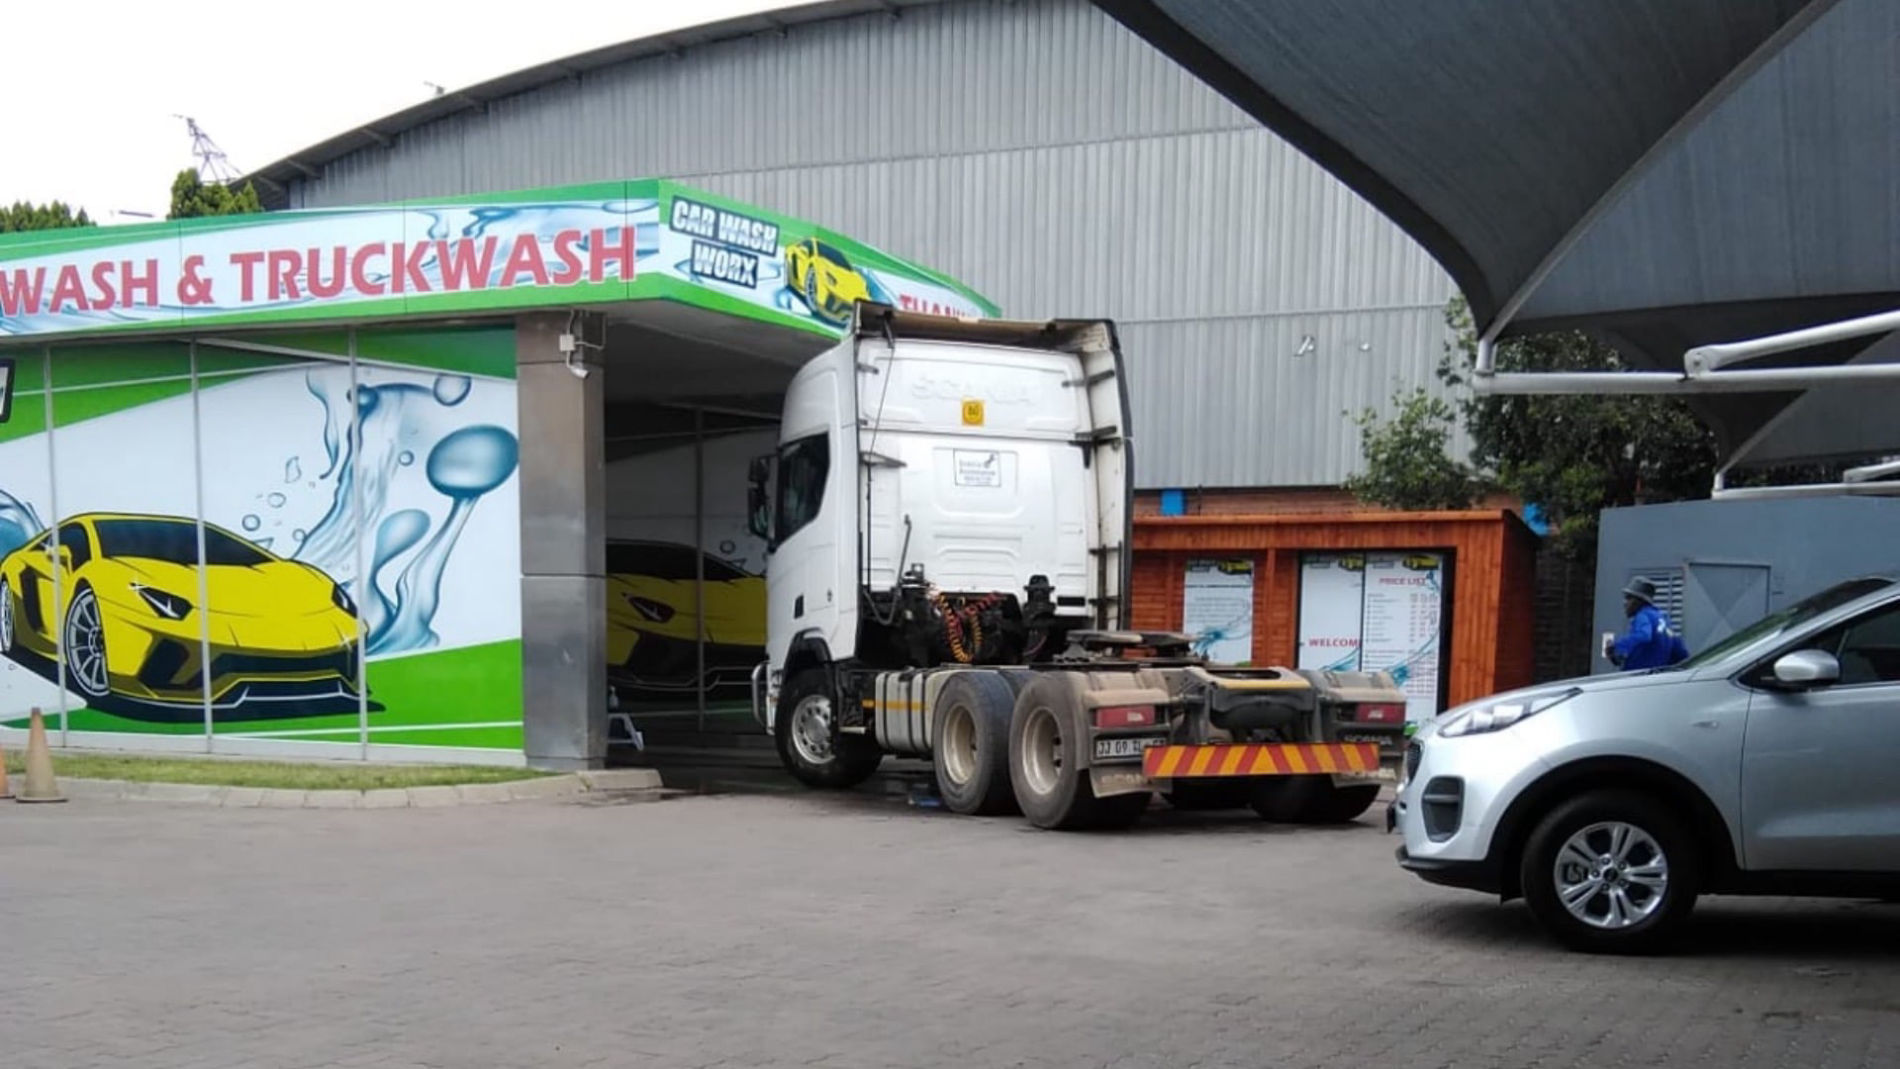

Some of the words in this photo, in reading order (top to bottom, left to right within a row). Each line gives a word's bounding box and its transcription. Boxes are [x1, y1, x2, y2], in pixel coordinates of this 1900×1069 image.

[672, 201, 716, 236] CAR
[718, 212, 777, 252] WASH
[0, 259, 158, 316] WASH
[177, 255, 214, 305] &
[230, 226, 636, 302] TRUCKWASH
[694, 247, 756, 285] WORX
[1379, 577, 1405, 586] PRICE
[1309, 637, 1361, 647] WELCOM
